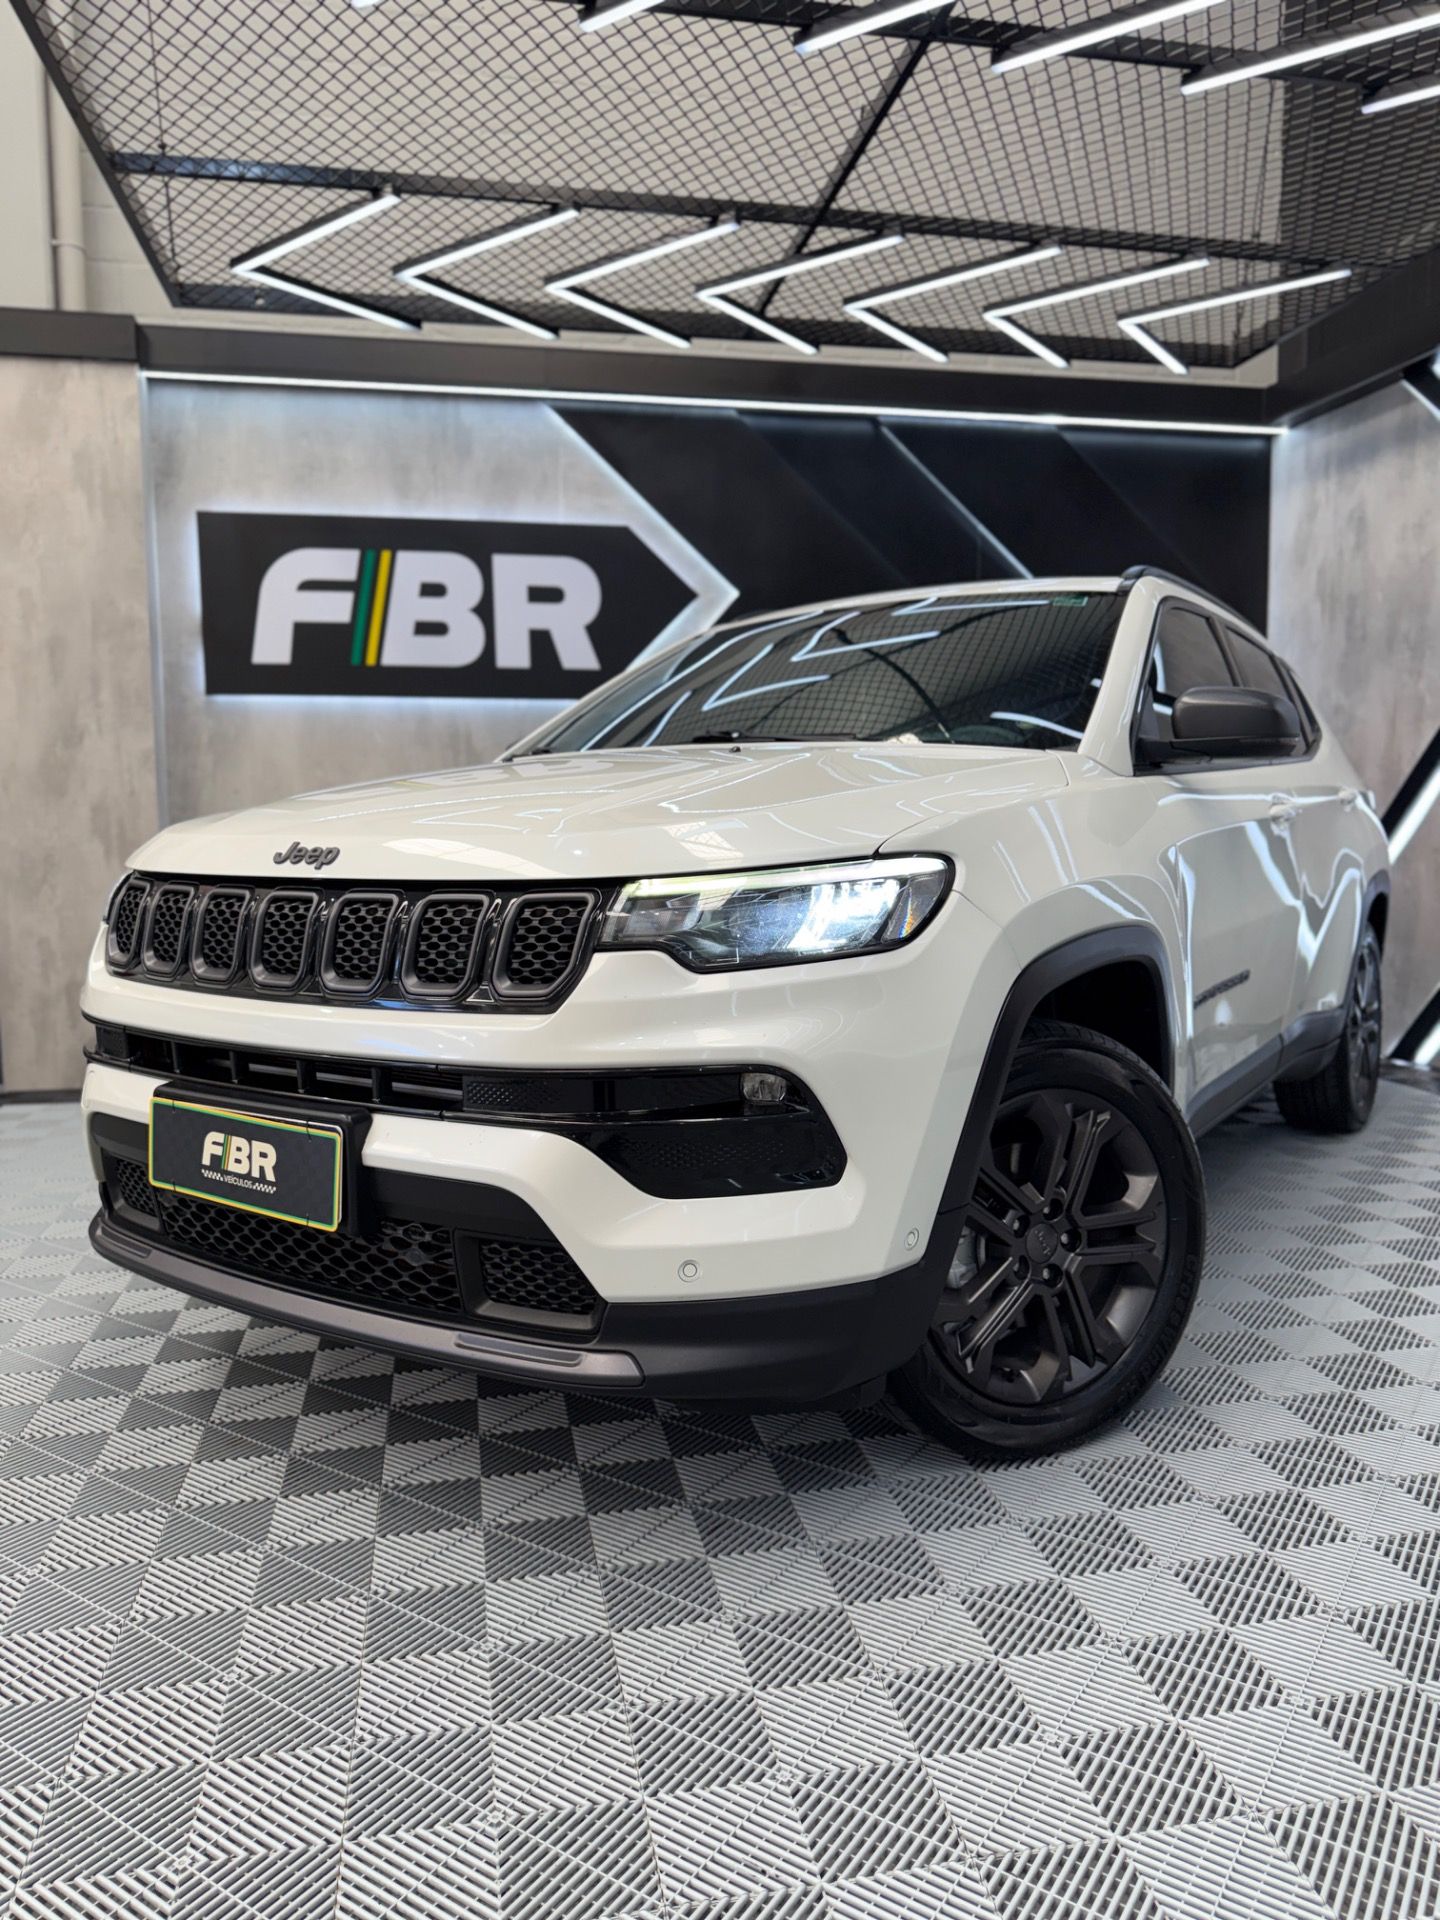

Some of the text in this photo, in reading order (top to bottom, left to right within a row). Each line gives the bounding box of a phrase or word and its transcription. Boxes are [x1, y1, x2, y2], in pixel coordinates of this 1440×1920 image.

[251, 547, 602, 671] FBR
[273, 841, 340, 870] Jeep
[202, 1131, 277, 1182] FBR
